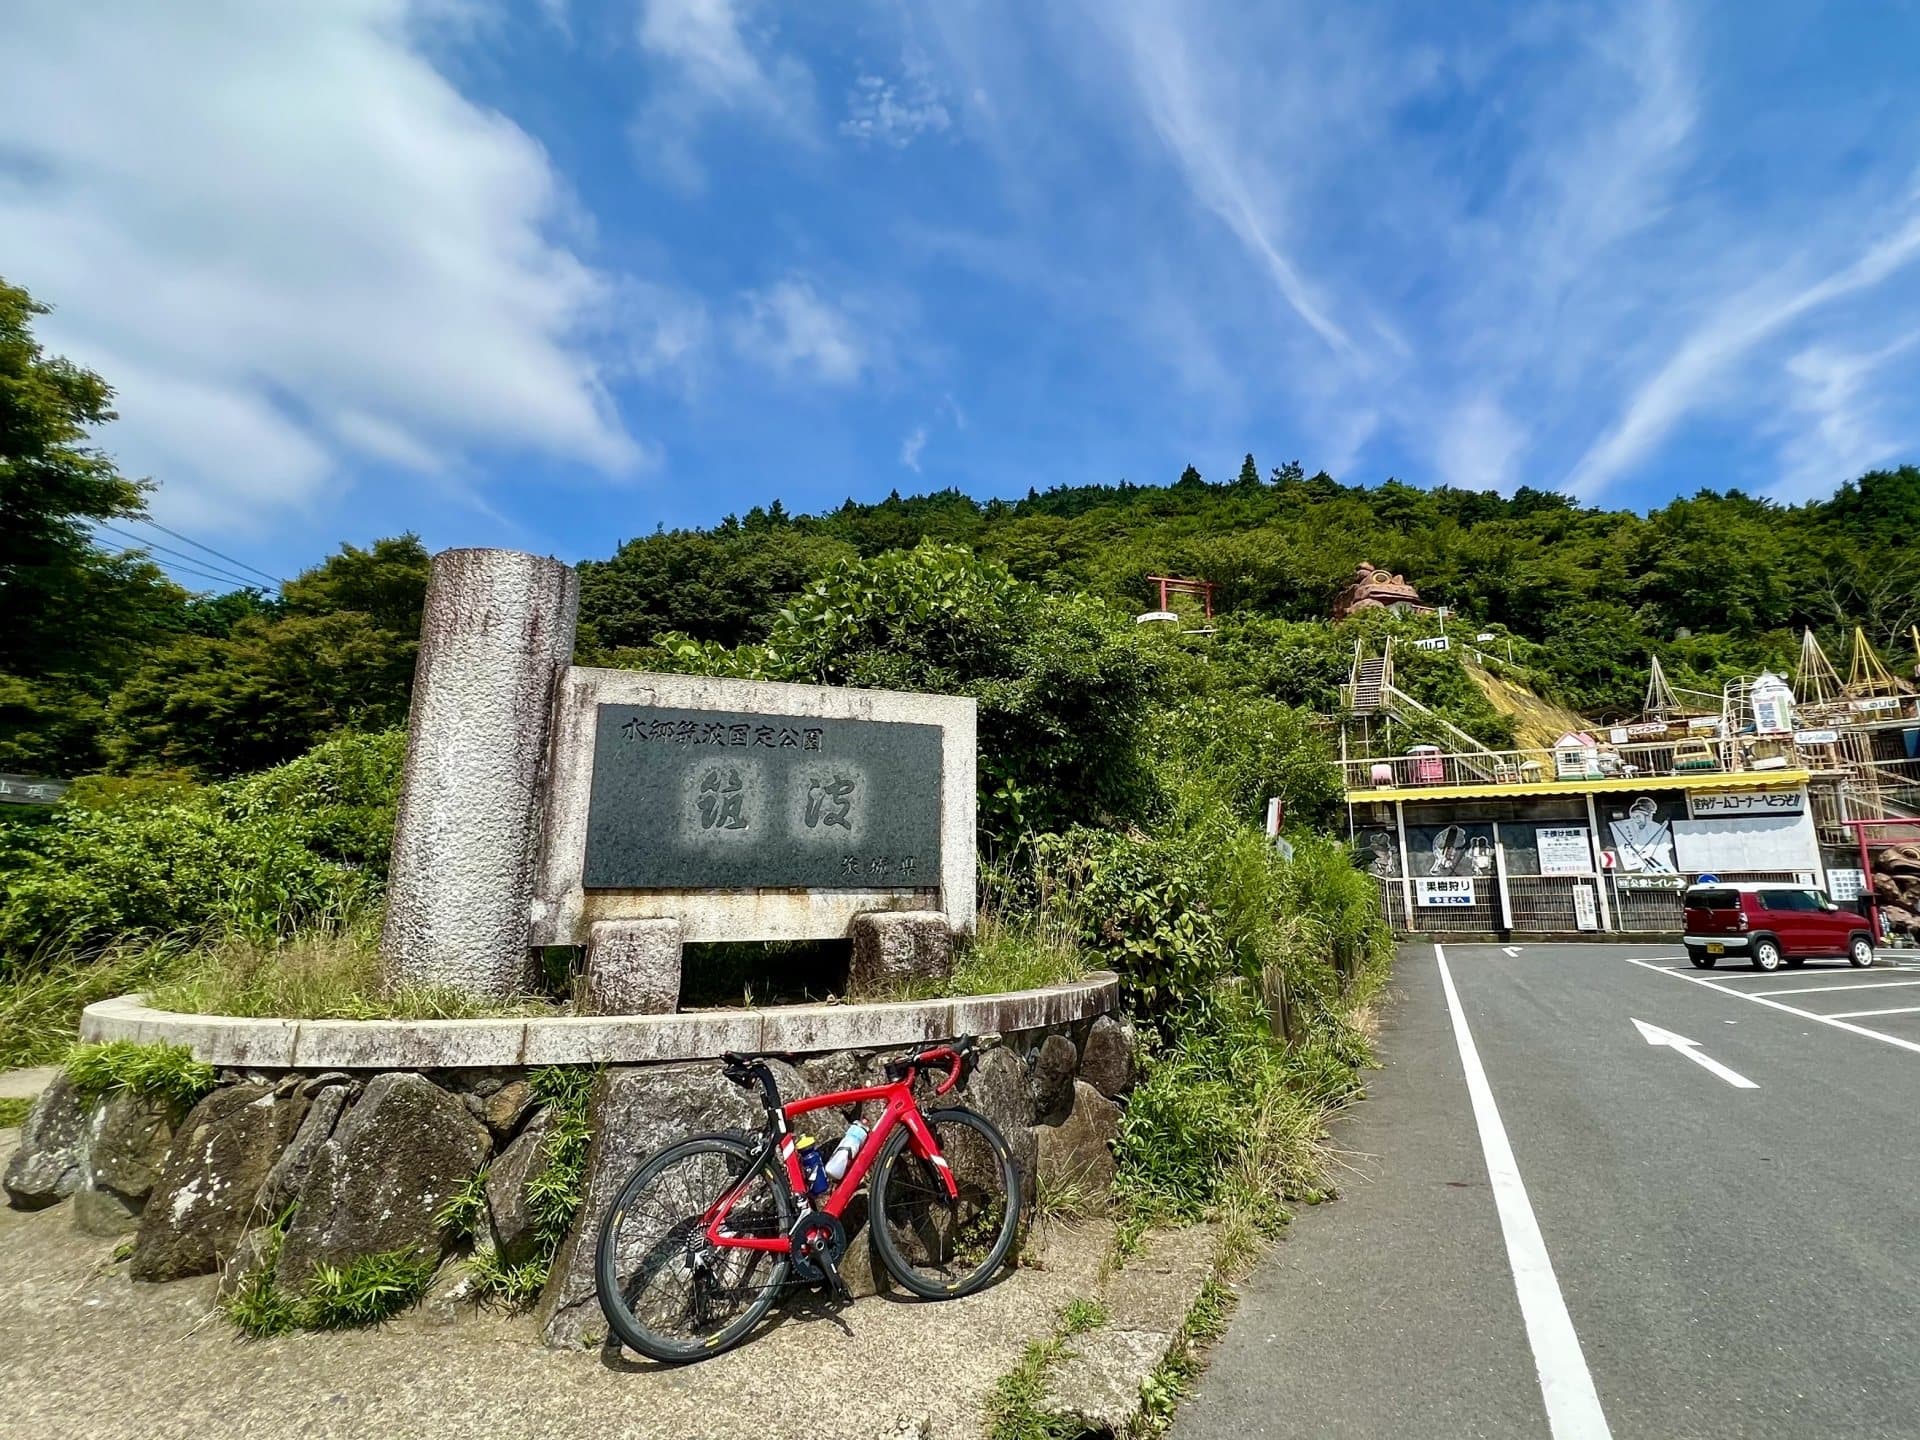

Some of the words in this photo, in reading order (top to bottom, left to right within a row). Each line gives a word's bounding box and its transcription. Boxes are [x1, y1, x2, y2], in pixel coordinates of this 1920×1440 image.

[621, 717, 824, 752] 水郷筑波国定公園
[840, 855, 917, 877] 茨城県
[1427, 880, 1470, 892] 果樹狩り
[1630, 878, 1672, 888] 公衆トイレ
